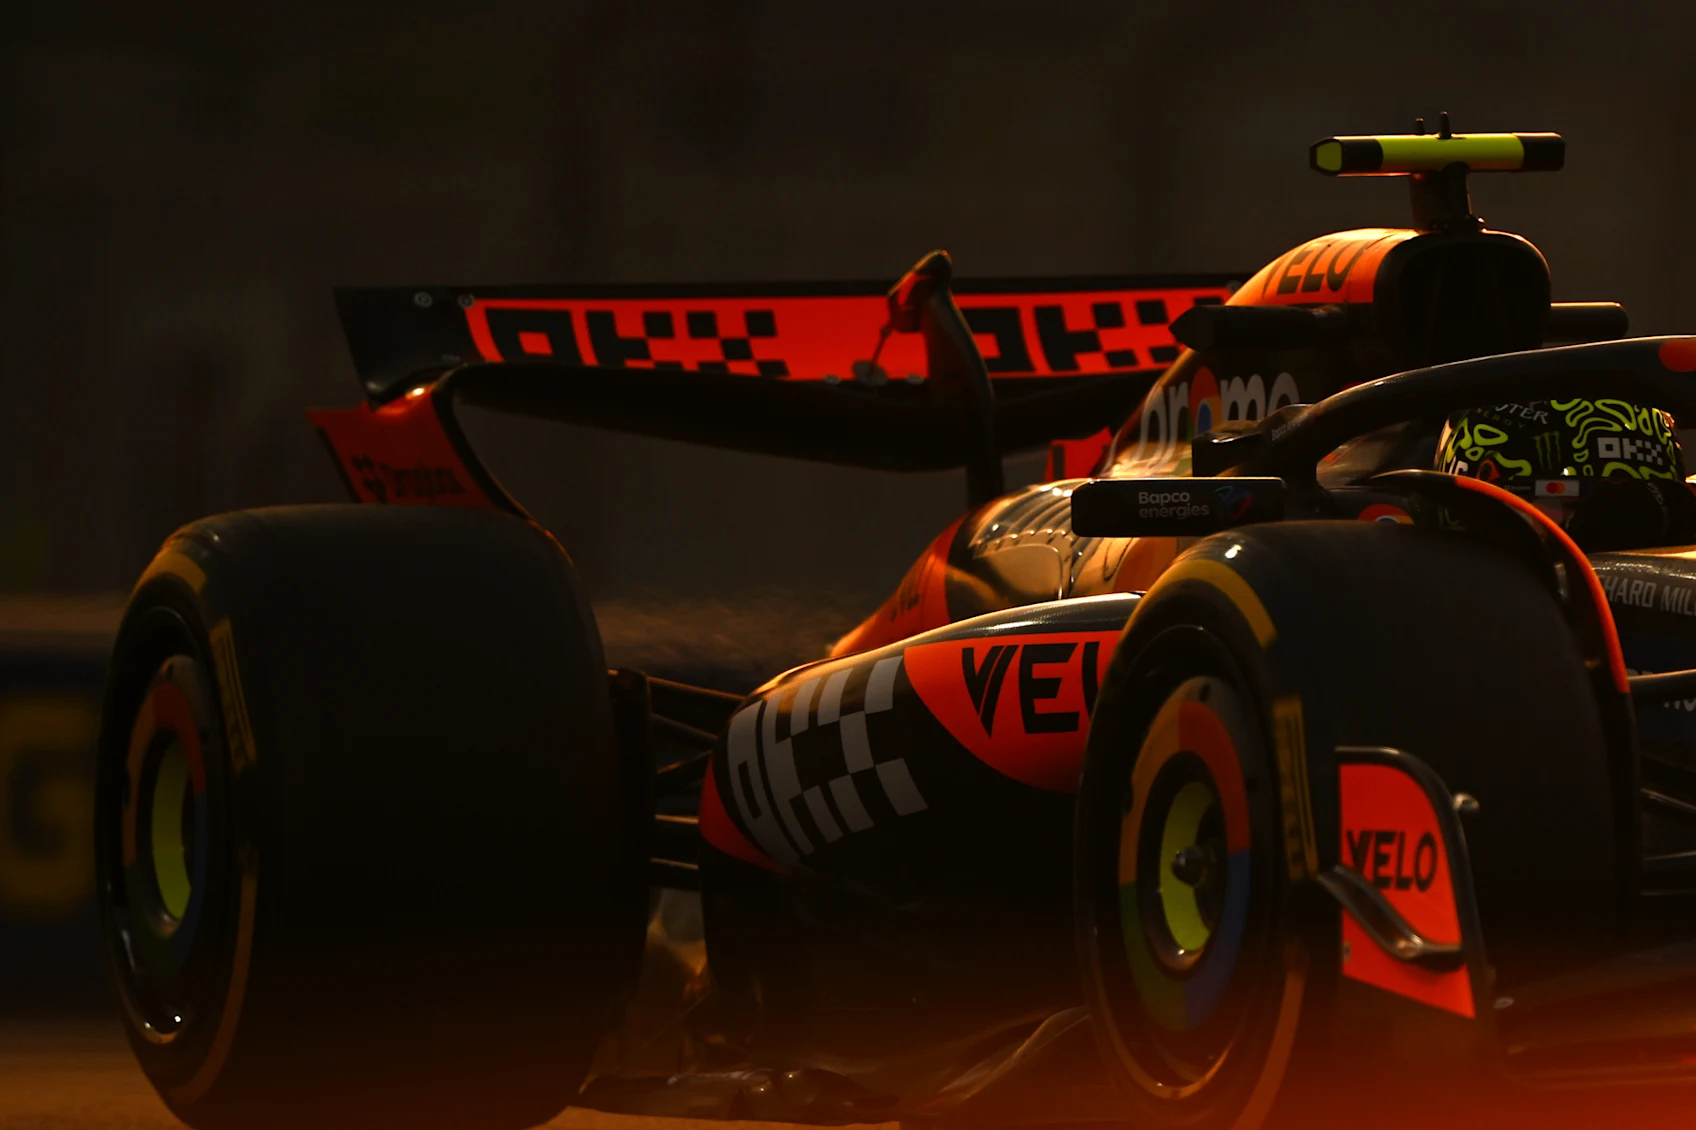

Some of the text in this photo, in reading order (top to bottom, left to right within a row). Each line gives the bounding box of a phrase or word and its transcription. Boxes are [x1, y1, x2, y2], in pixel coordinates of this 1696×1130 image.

[1597, 436, 1664, 467] OKX
[1138, 491, 1191, 508] Bapco
[1138, 502, 1210, 519] energies
[1347, 828, 1438, 894] VELO
